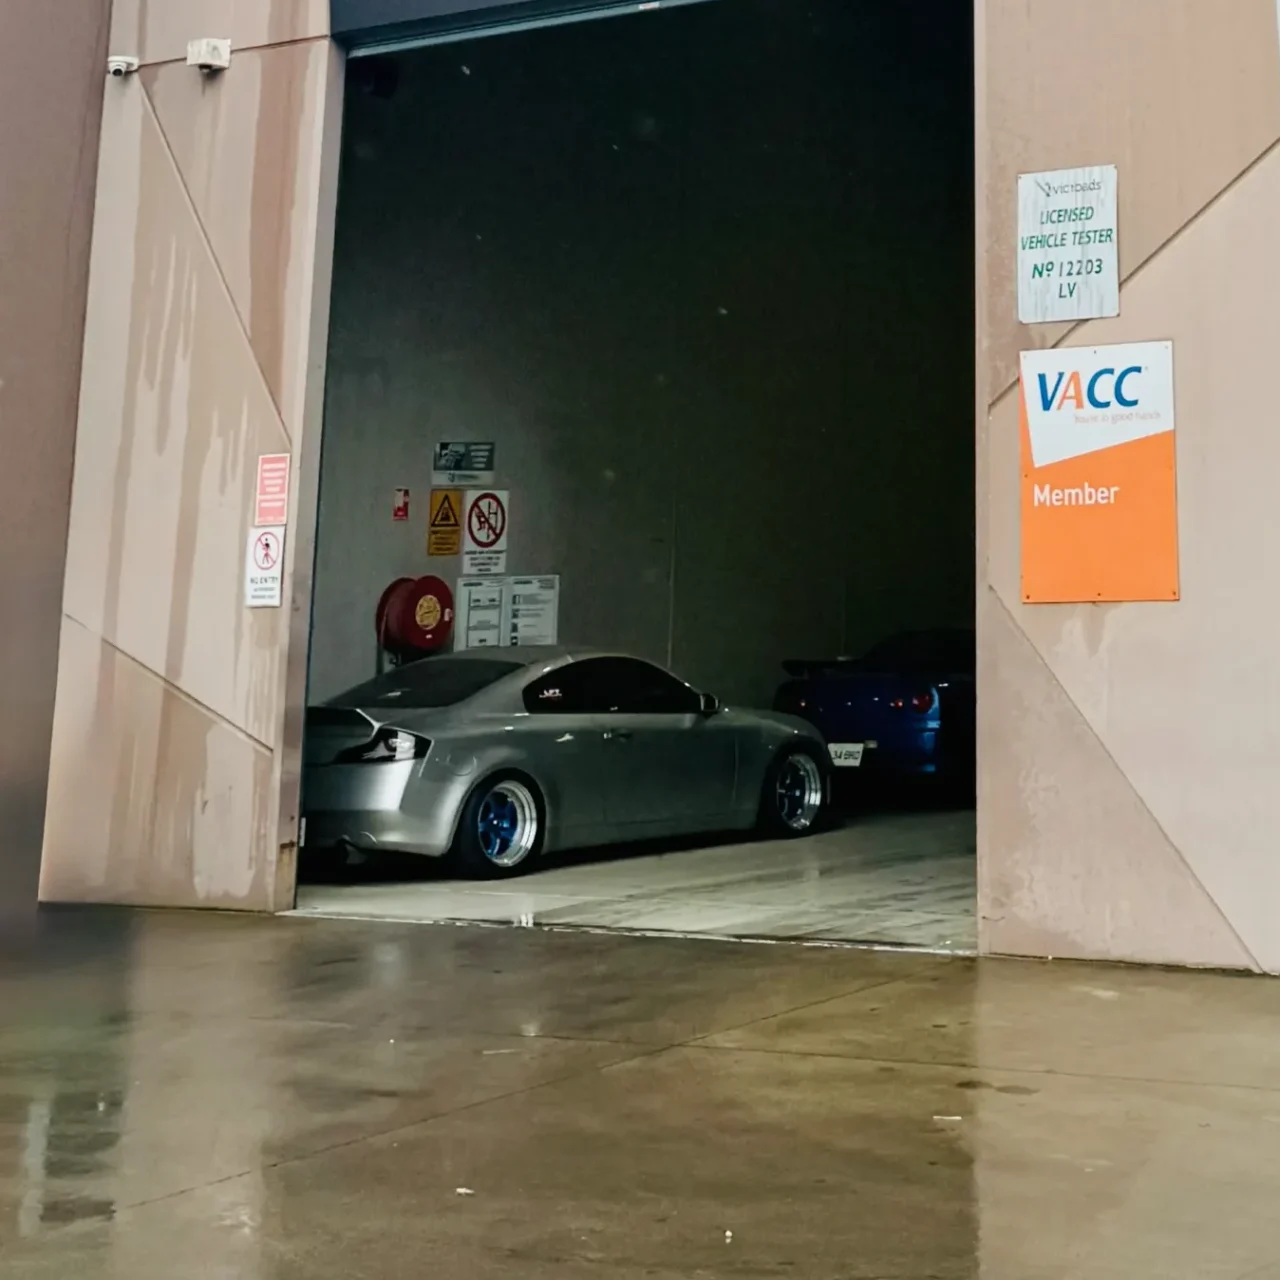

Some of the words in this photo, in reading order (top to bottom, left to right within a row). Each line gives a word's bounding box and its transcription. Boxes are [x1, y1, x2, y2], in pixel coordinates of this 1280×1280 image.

[1040, 206, 1095, 225] LICENSED
[1021, 232, 1068, 250] VEHICLE
[1072, 228, 1113, 246] TESTER
[1059, 258, 1103, 277] 12203
[1058, 282, 1077, 299] LV
[1037, 366, 1143, 412] VACC
[1033, 482, 1120, 507] Member
